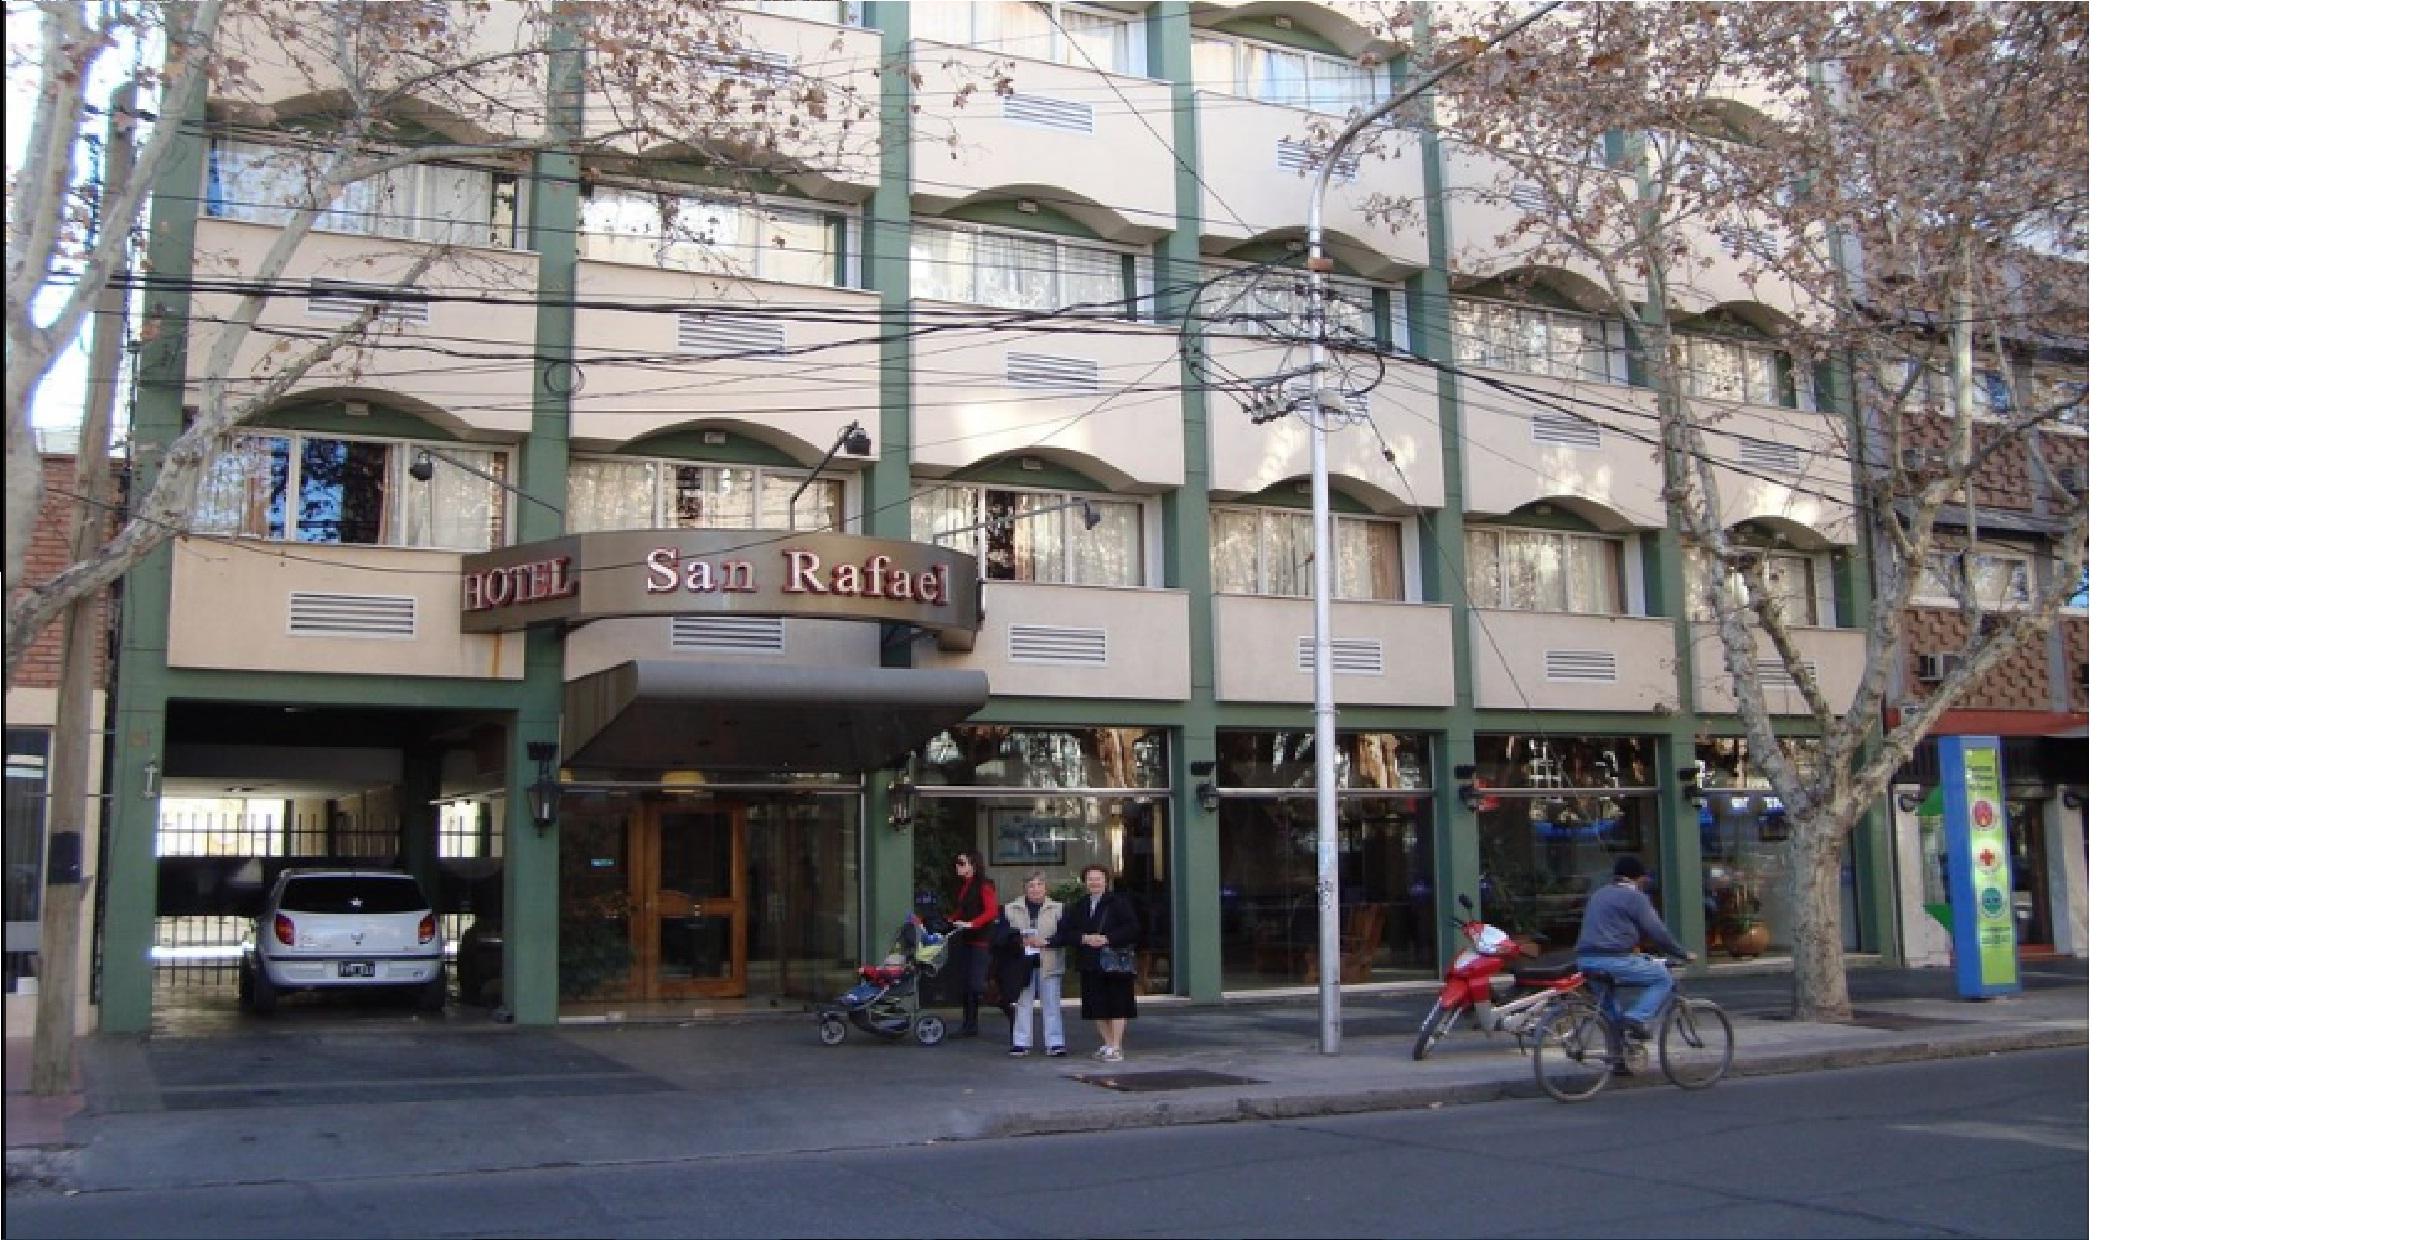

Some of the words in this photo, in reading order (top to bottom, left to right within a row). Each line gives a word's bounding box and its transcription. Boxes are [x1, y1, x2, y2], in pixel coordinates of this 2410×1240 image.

[463, 556, 580, 611] HOTEL
[646, 547, 758, 594] San
[782, 548, 951, 606] Rafael
